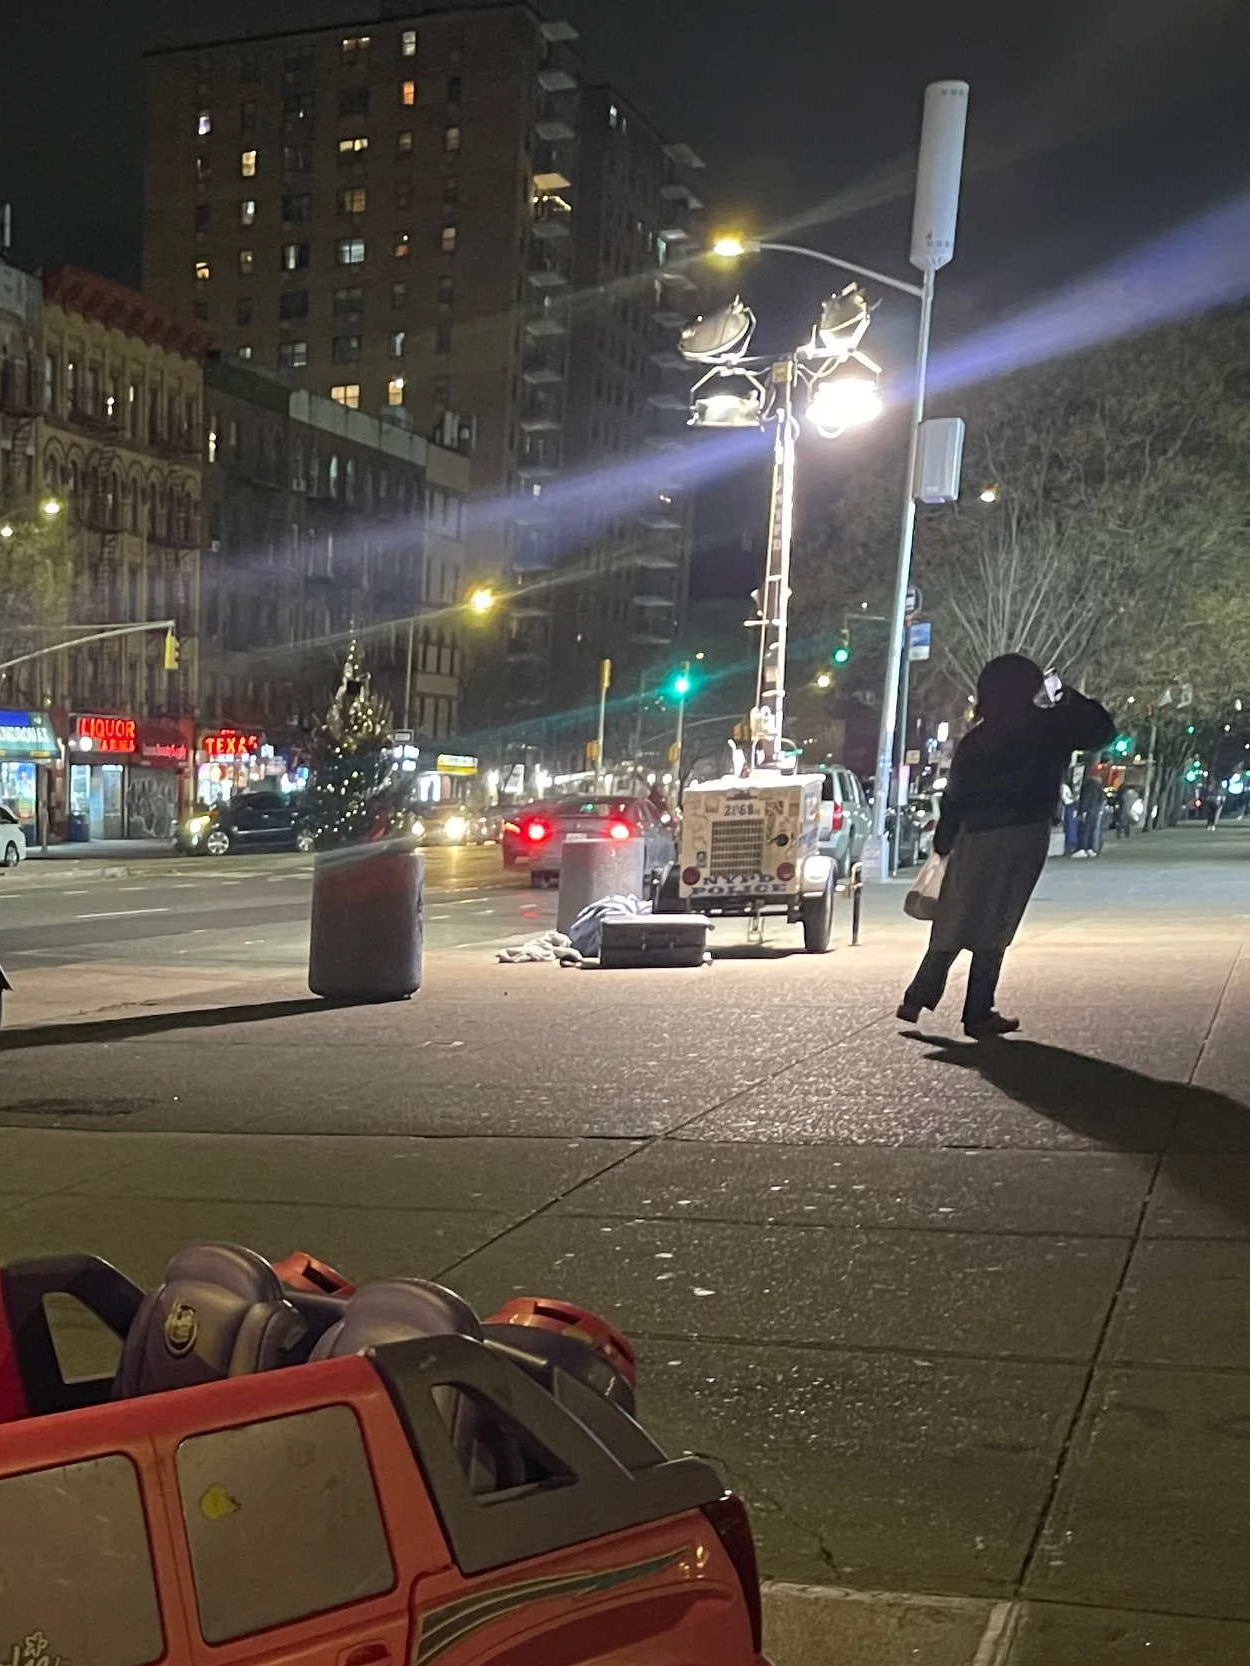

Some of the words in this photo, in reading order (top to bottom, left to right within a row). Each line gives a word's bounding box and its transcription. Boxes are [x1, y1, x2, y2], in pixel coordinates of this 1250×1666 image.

[81, 717, 136, 738] LIQUOR
[703, 874, 775, 885] NYPD
[691, 884, 786, 895] POLICE
